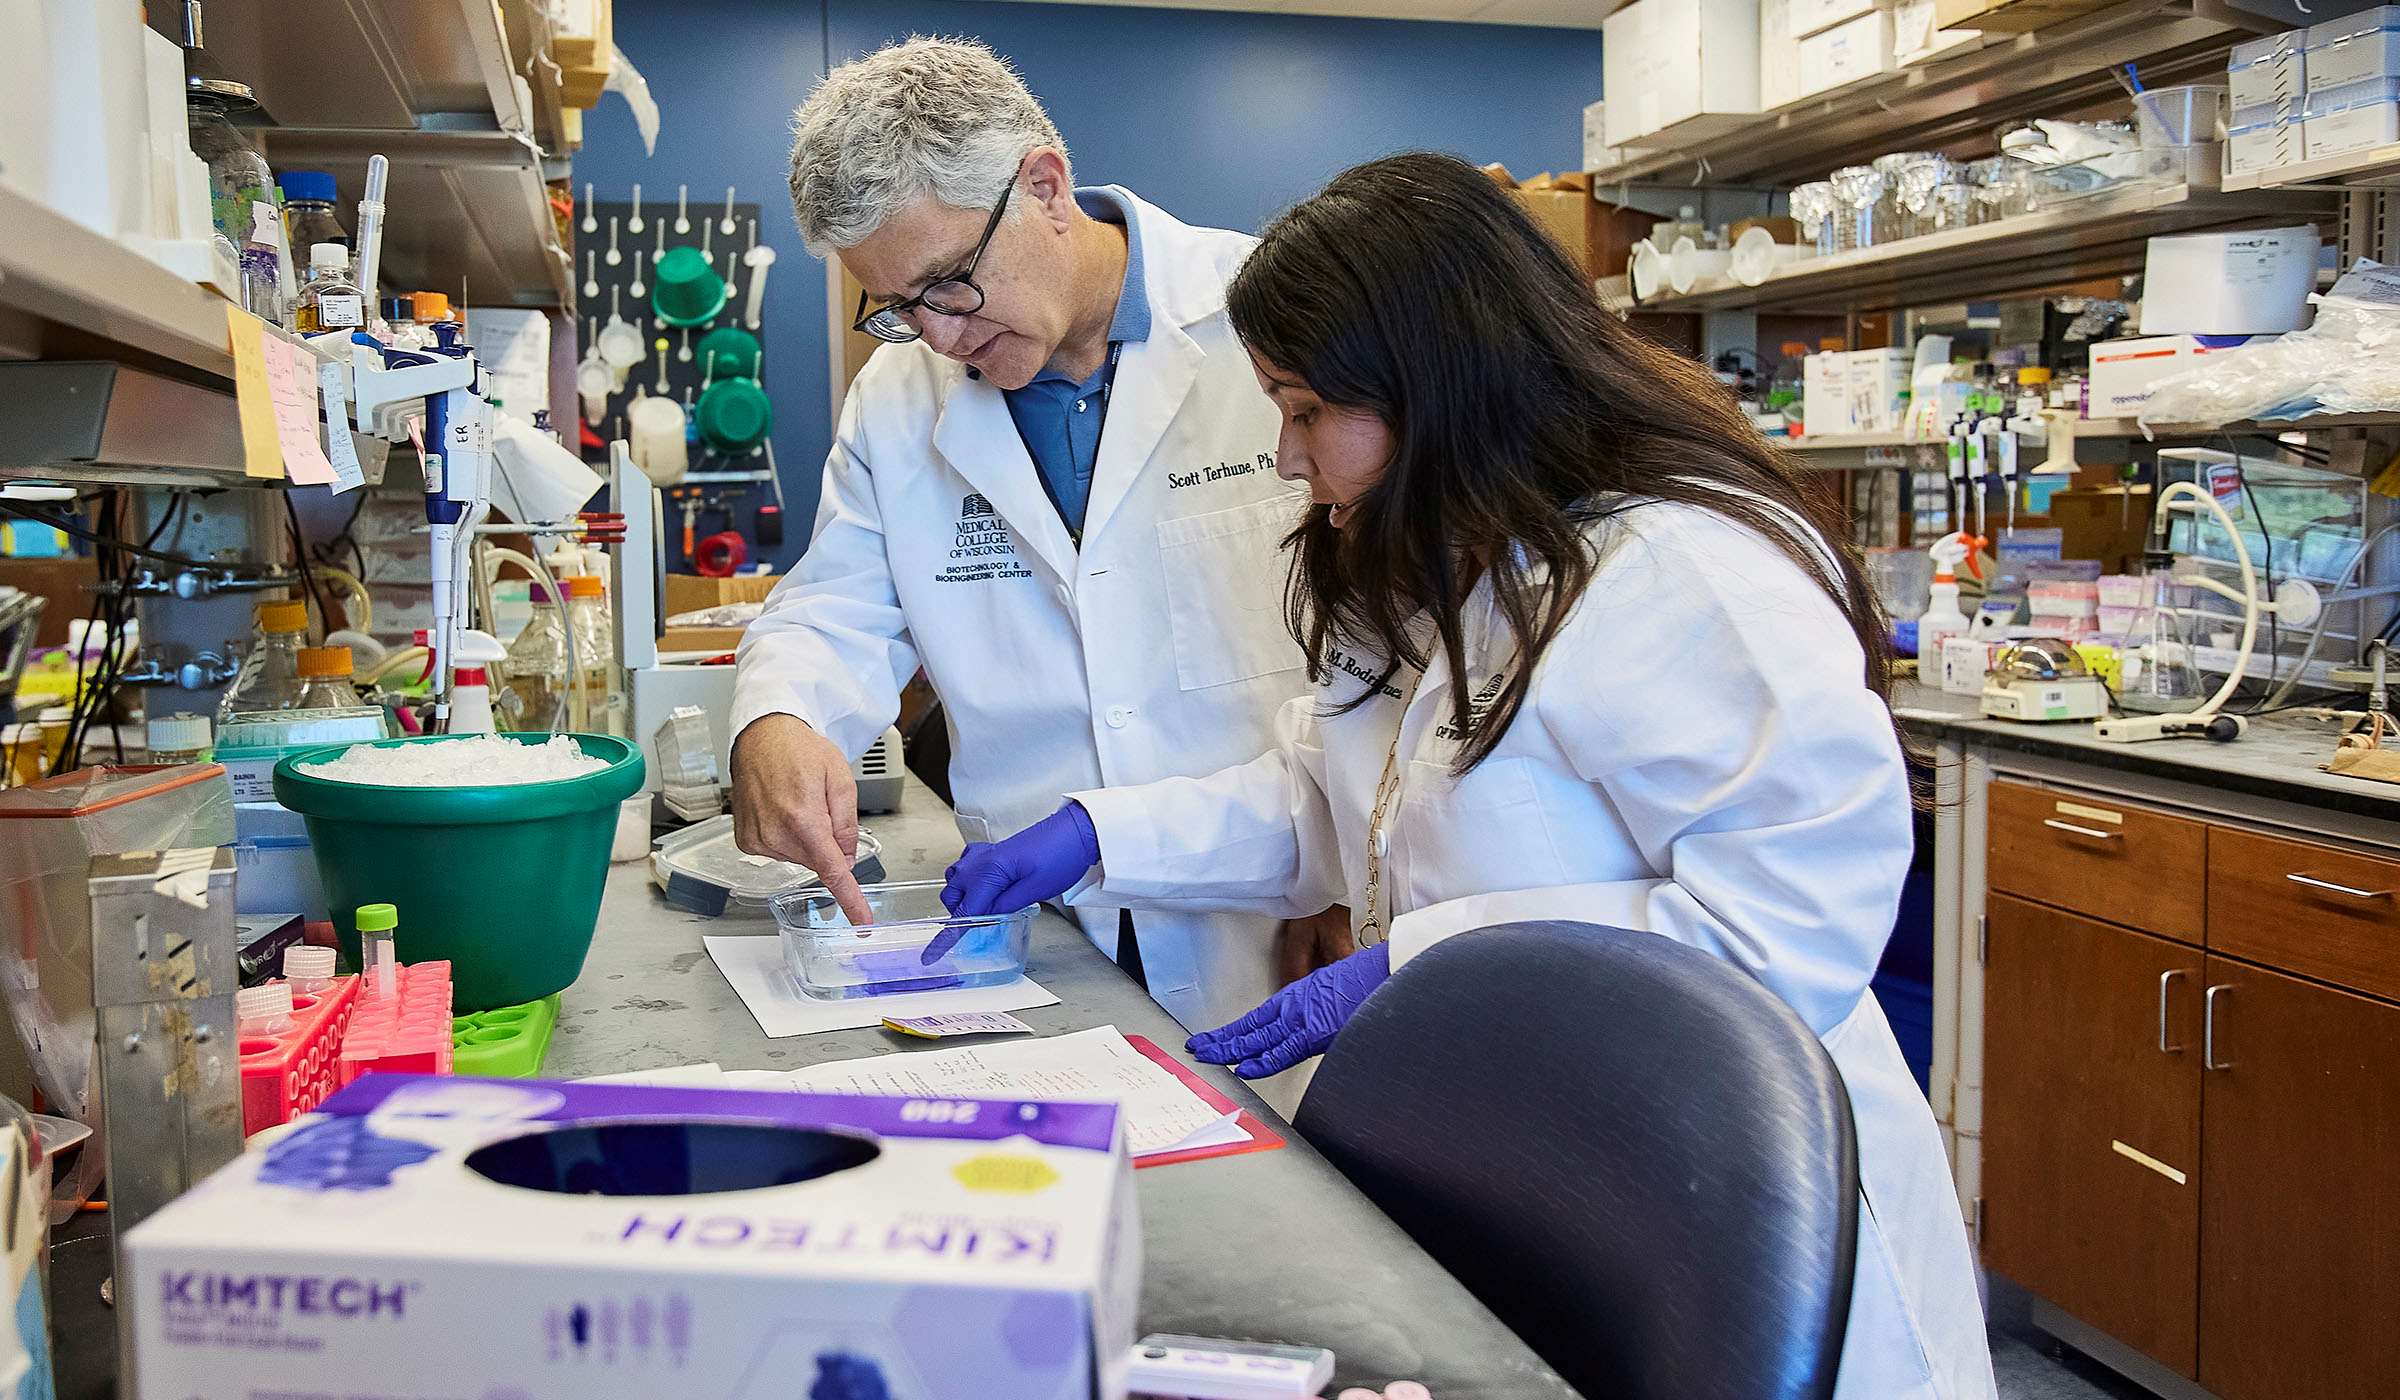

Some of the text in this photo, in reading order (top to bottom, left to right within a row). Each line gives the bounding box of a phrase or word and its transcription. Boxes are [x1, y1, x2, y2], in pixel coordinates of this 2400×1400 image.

[1168, 451, 1277, 489] Scott Terhune, Ph
[955, 518, 1007, 535] MEDICAL
[955, 531, 1009, 548] COLLEGE
[950, 545, 1015, 559] OF WISCONSIN
[935, 569, 1033, 583] BIOENGINEERING CENTER
[946, 561, 1020, 574] BIOTECHNOLOGY &
[900, 1100, 981, 1124] 200
